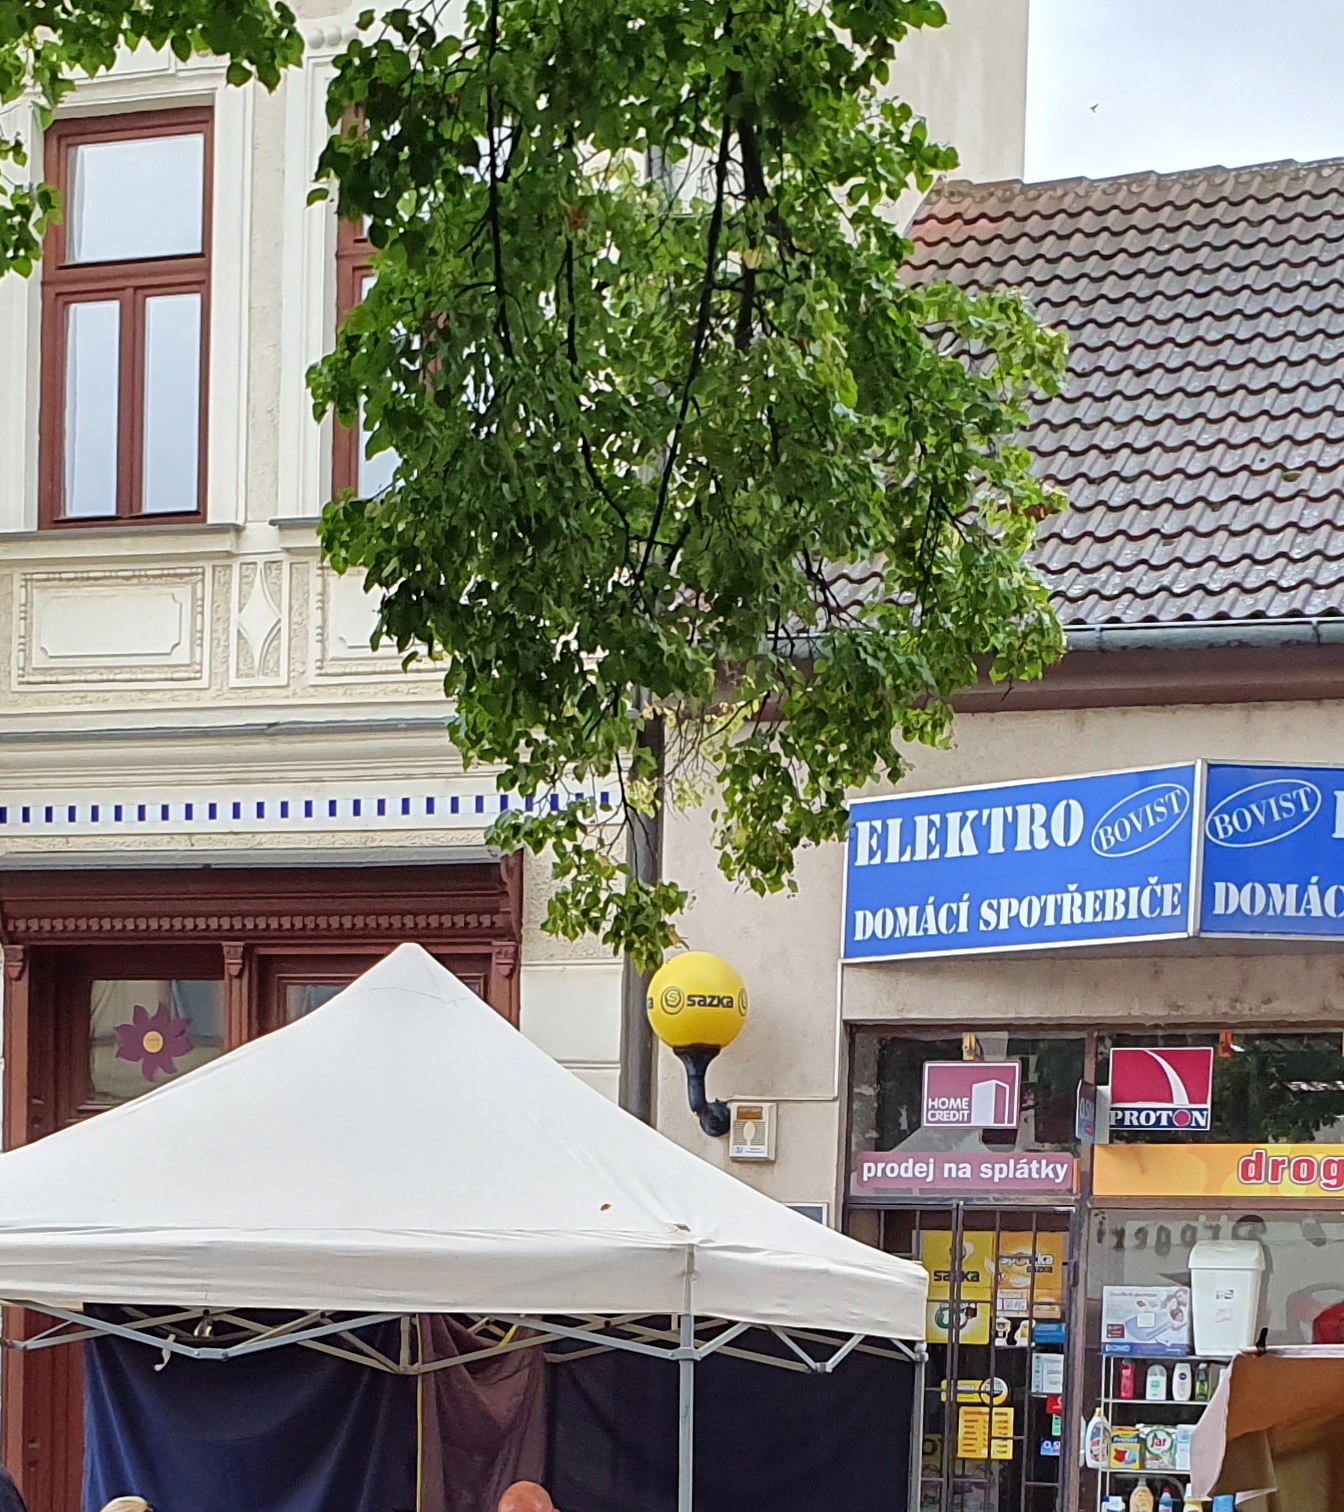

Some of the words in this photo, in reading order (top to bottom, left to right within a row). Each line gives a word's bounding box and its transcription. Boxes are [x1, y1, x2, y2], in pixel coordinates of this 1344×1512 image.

[1214, 787, 1316, 837] BOVIST
[854, 799, 1085, 867] ELEKTRO
[1099, 793, 1185, 852] BOVIST
[853, 891, 971, 942] DOMÁCÍ
[979, 876, 1183, 934] SPOTŘEBIČE
[686, 993, 735, 1009] sazka
[927, 1097, 970, 1110] HOME
[927, 1110, 970, 1122] CREDIT
[1108, 1109, 1208, 1127] PROTON
[862, 1158, 935, 1182] prodej
[943, 1161, 972, 1179] na
[979, 1158, 1069, 1183] splátky
[933, 1269, 981, 1283] saka
